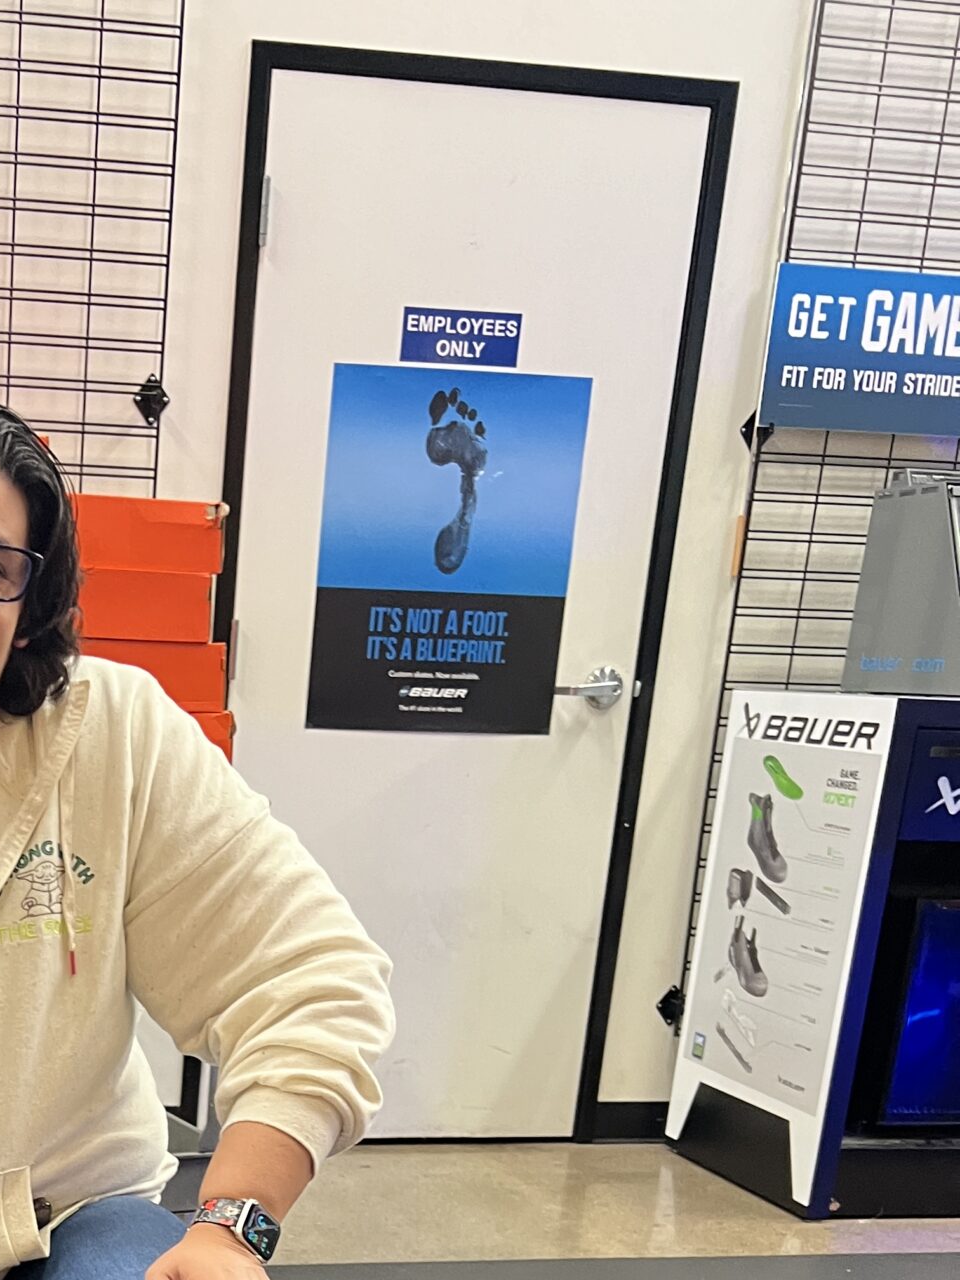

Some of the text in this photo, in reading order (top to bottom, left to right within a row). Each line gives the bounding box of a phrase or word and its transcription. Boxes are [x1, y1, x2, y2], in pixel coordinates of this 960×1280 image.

[406, 314, 518, 338] EMPLOYEES
[787, 292, 858, 341] GET
[435, 339, 486, 358] ONLY
[780, 365, 809, 389] FIT
[812, 366, 847, 391] FOR
[852, 369, 898, 394] YOUR
[368, 606, 510, 637] IT'S NOT A FOOT.
[366, 635, 506, 664] IT'S A BLUEPRINT.
